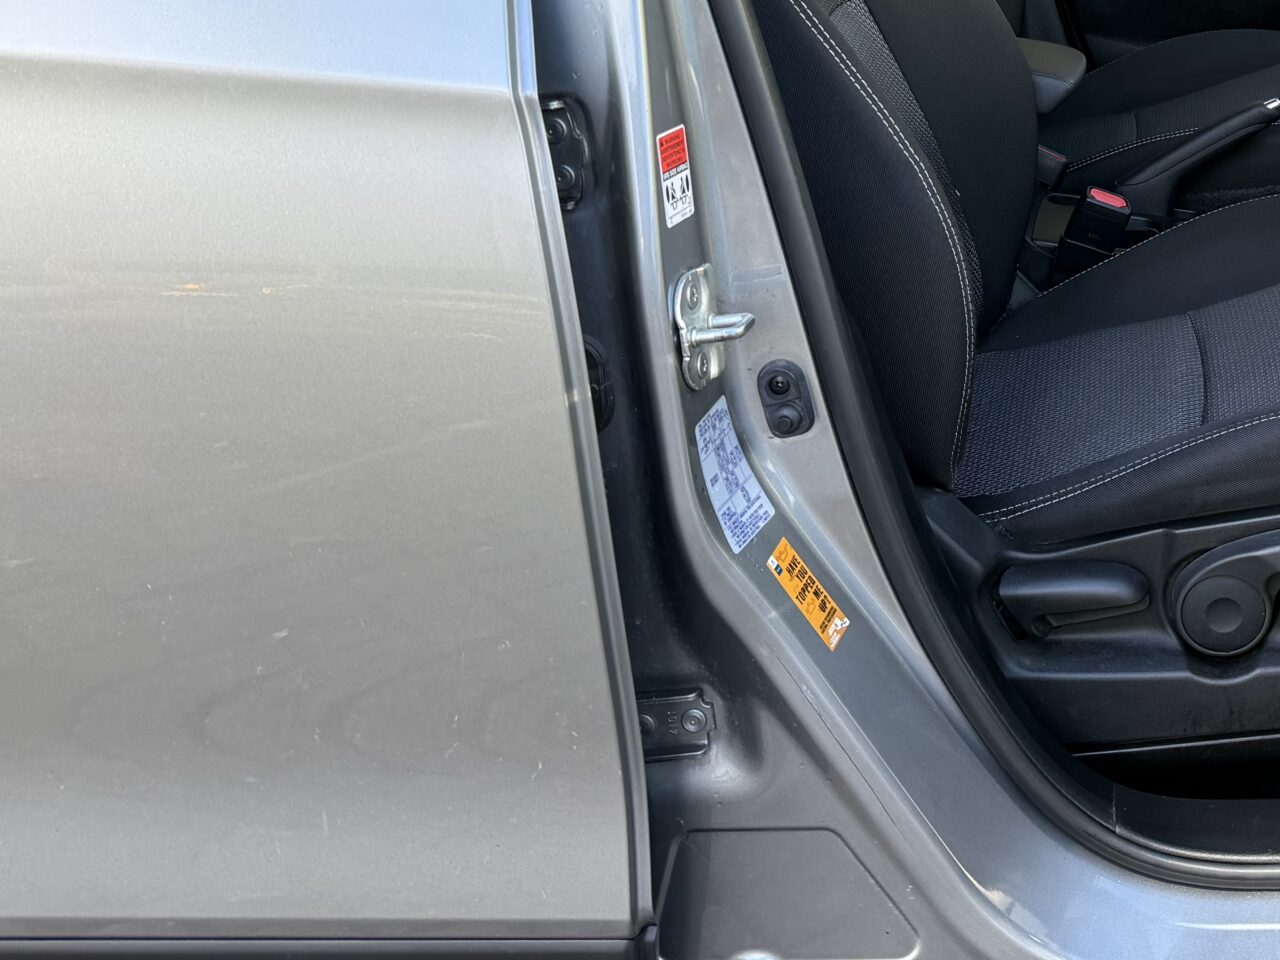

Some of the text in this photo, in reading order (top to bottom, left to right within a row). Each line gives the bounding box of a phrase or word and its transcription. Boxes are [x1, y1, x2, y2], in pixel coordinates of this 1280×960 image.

[785, 555, 801, 576] HAVE
[795, 565, 808, 583] YOU
[795, 575, 816, 605] TOPPED
[812, 584, 824, 600] ME
[818, 594, 831, 613] UP?
